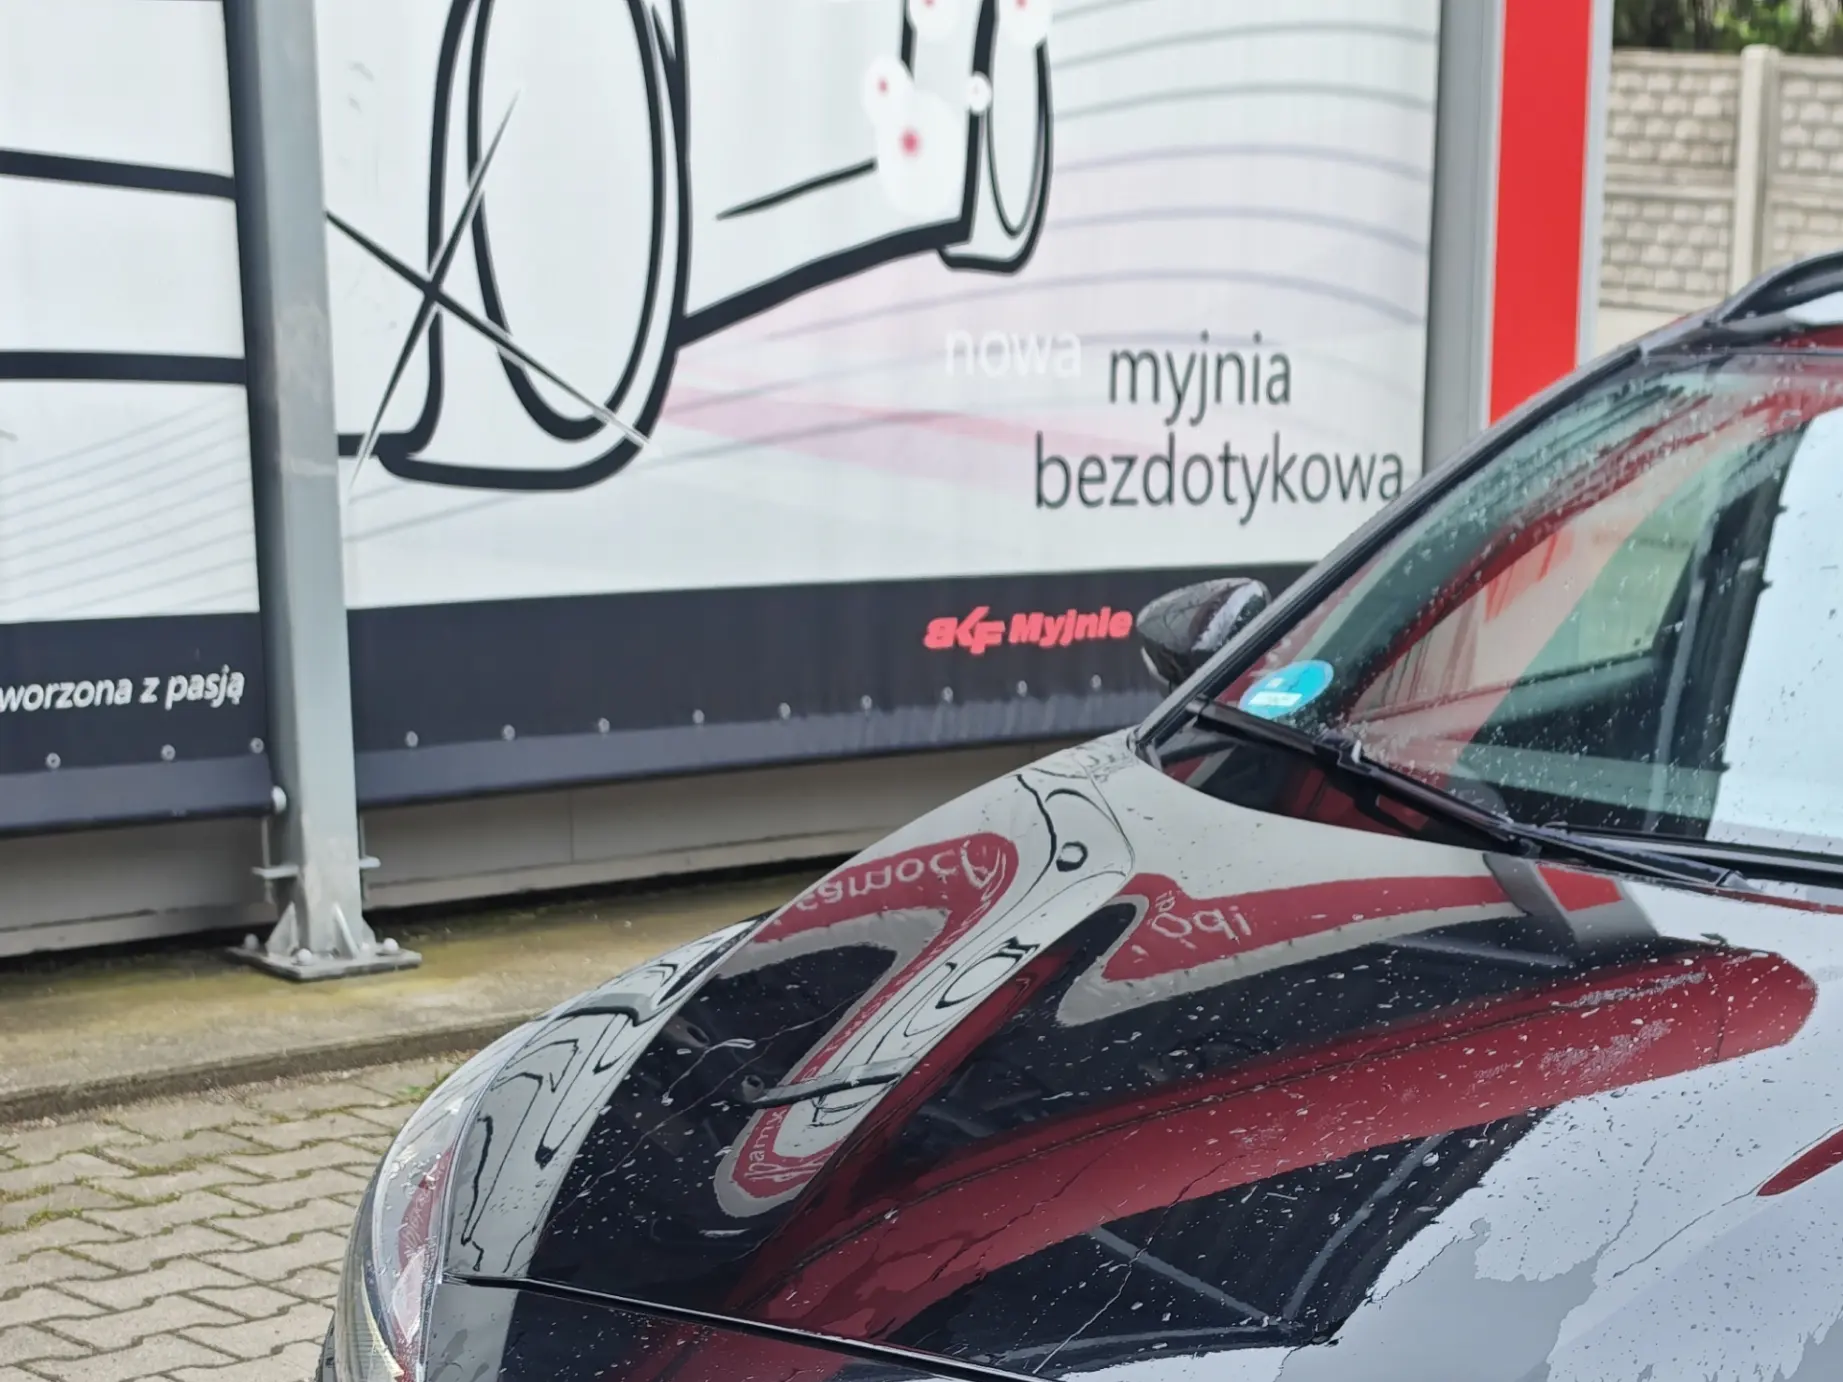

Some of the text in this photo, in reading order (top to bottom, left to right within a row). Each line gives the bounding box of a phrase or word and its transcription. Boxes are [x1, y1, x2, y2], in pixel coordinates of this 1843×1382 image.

[944, 328, 1291, 427] nowa myjnia
[1035, 430, 1404, 526] bezdotykowa
[1008, 606, 1133, 647] Myjnie
[140, 676, 160, 703] z
[165, 664, 245, 711] pasją
